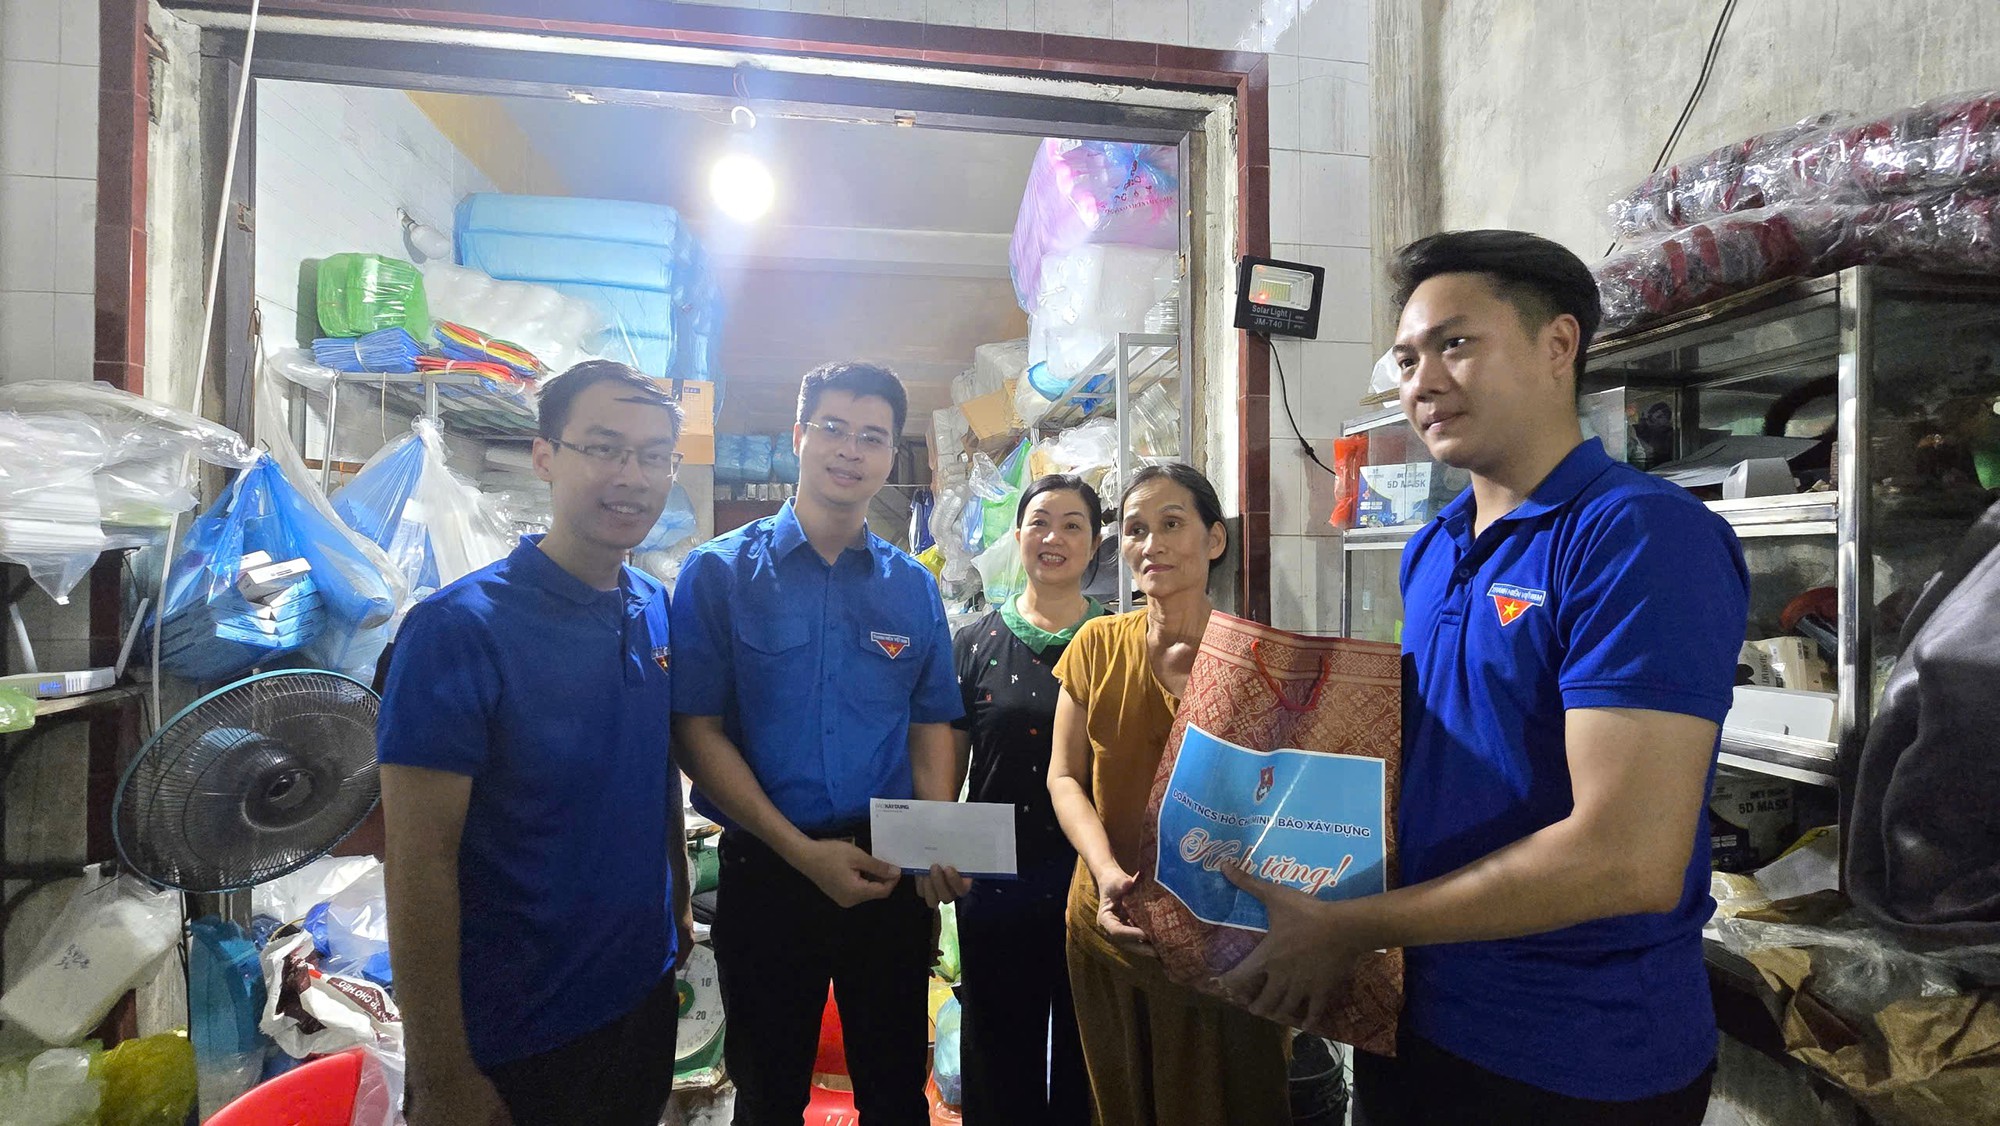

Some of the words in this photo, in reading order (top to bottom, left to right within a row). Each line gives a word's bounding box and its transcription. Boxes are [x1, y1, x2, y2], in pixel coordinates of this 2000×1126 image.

[1252, 305, 1270, 315] Solar
[1270, 308, 1288, 318] Light
[1254, 318, 1283, 328] JM-T40
[1387, 481, 1399, 489] 5D
[1739, 802, 1754, 815] 5D
[1193, 803, 1218, 820] TNCS
[1278, 816, 1303, 829] BÁO
[1307, 819, 1332, 832] XÂY
[1334, 823, 1370, 838] DỰNG
[701, 978, 712, 987] 10
[696, 1010, 707, 1020] 20
